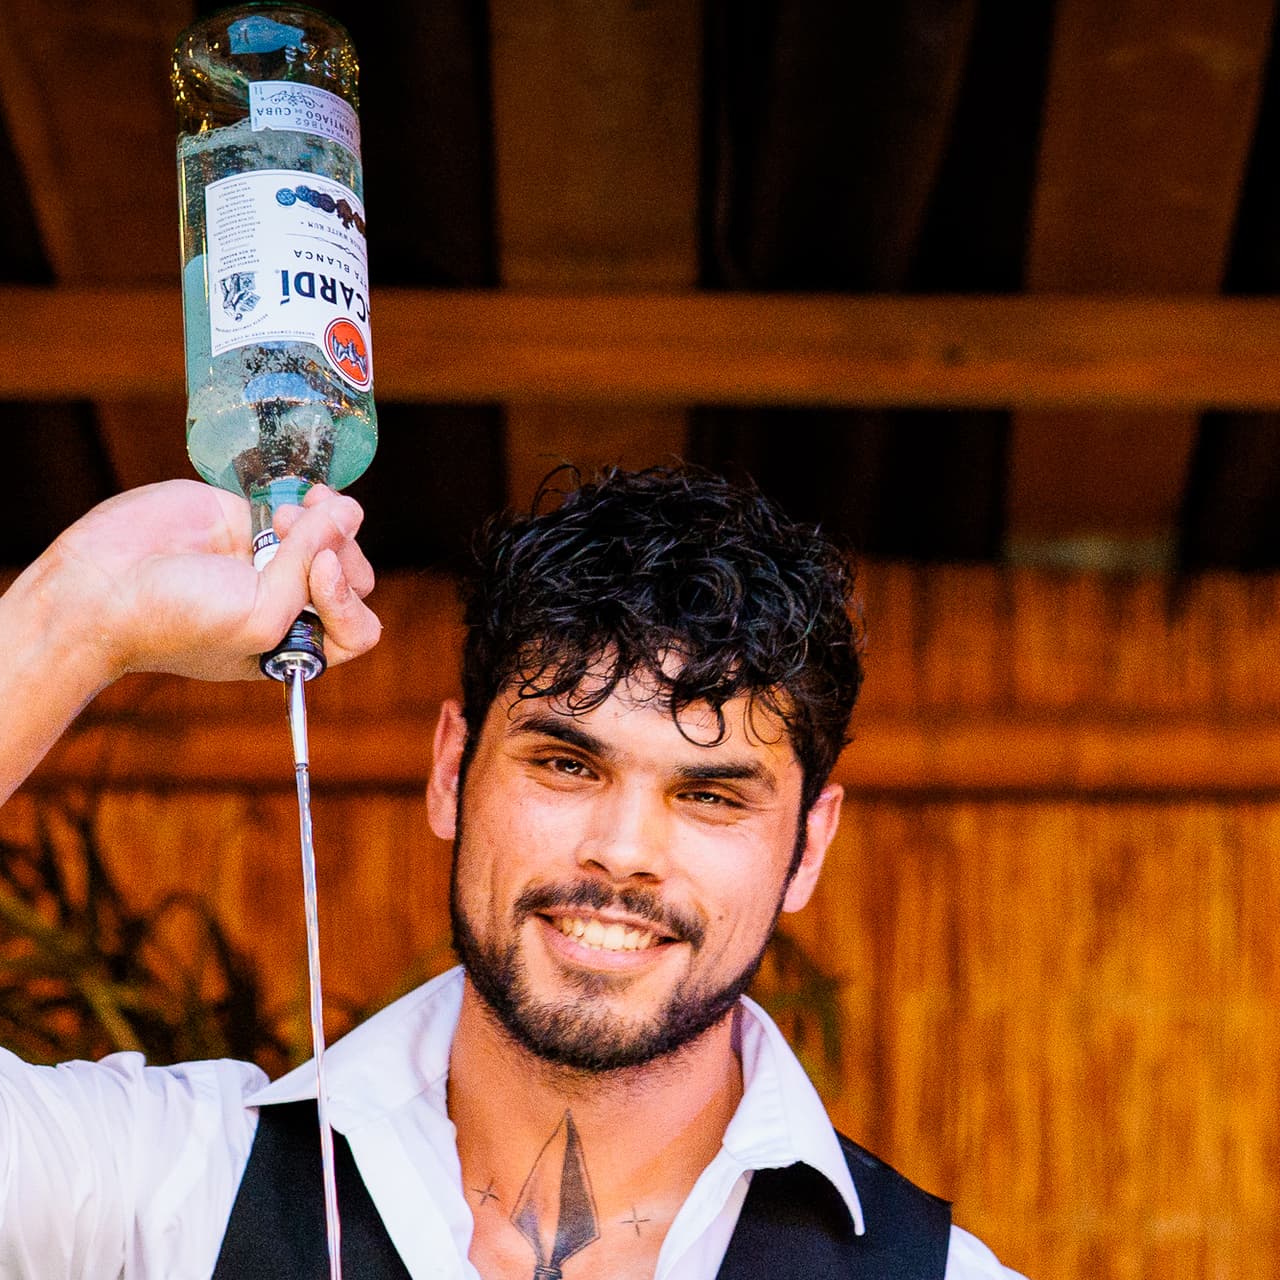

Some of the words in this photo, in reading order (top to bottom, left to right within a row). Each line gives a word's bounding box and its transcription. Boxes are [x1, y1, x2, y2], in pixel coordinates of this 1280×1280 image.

[256, 107, 292, 117] CUBA
[295, 118, 323, 130] 1862
[305, 110, 353, 139] SANTIAGO
[293, 250, 350, 274] BLANCA
[280, 270, 371, 323] CARDÍ
